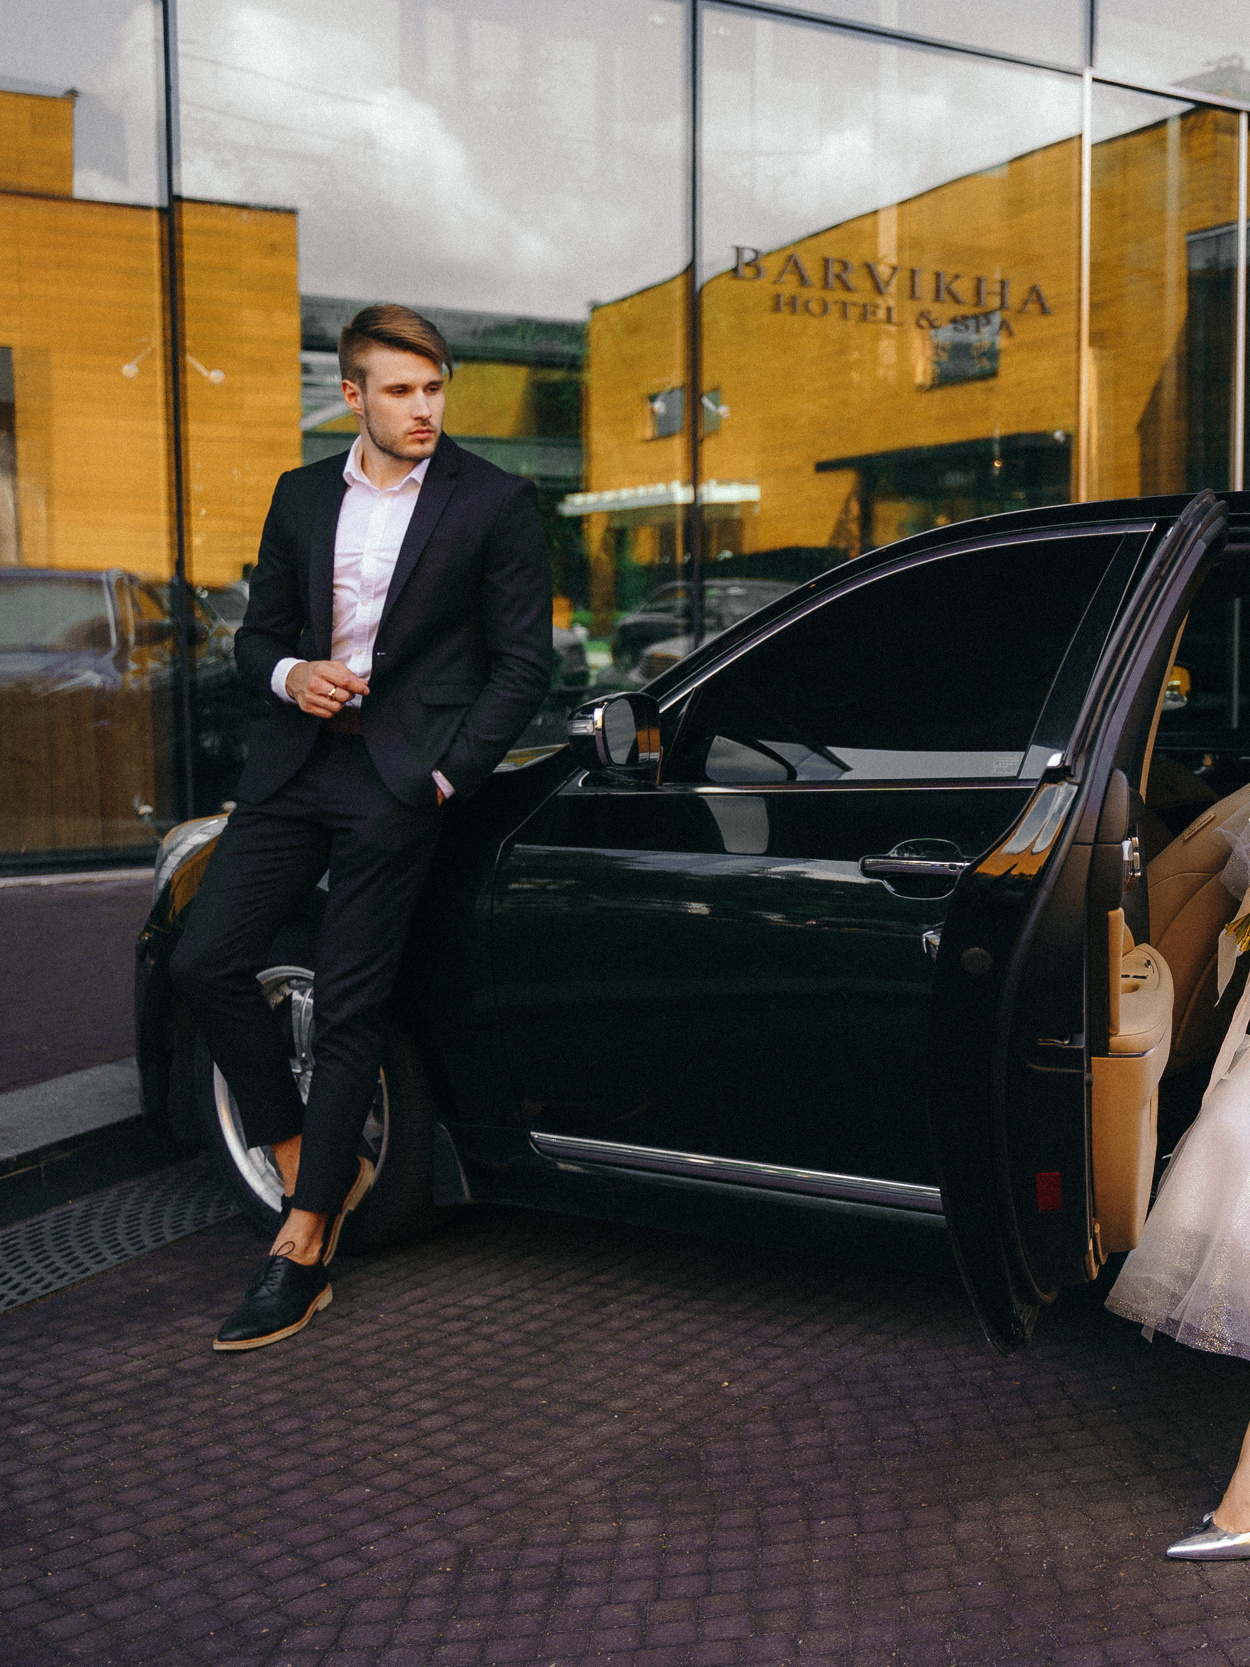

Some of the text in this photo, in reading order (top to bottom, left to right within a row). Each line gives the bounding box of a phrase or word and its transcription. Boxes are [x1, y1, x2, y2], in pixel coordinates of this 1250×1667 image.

[732, 246, 1052, 315] BARVIKHA
[774, 293, 1015, 337] HOTEL & SPA
